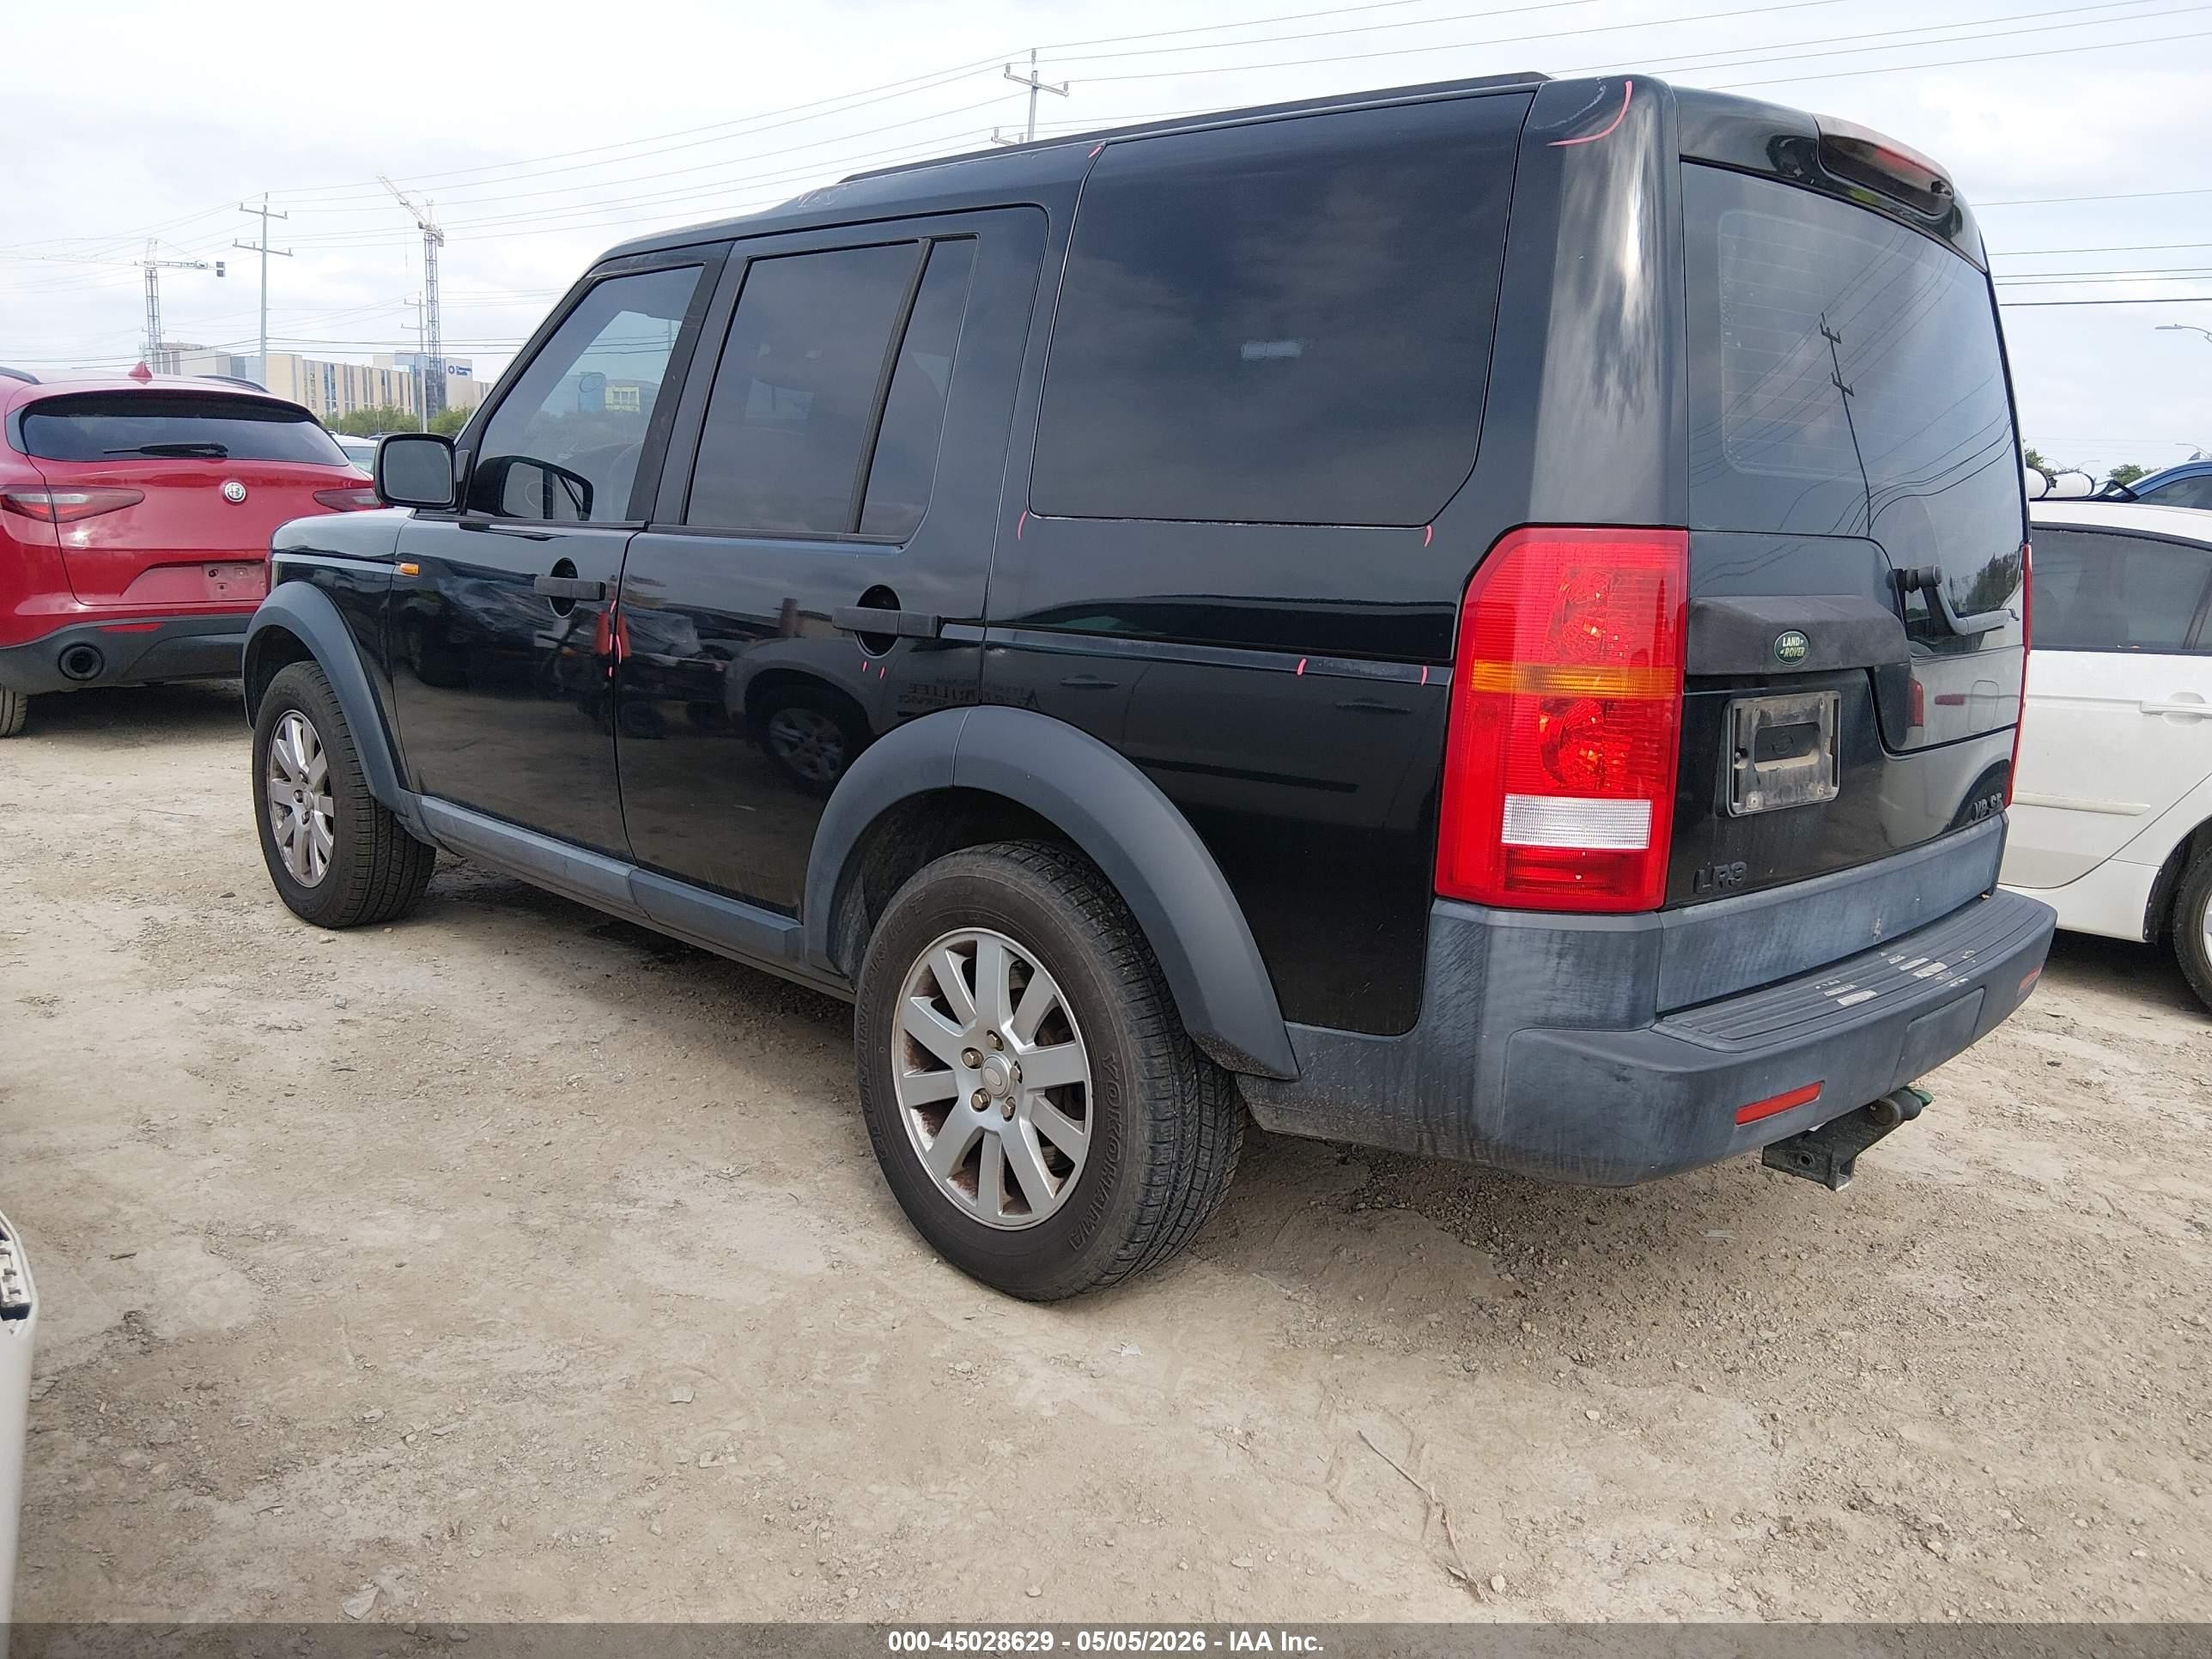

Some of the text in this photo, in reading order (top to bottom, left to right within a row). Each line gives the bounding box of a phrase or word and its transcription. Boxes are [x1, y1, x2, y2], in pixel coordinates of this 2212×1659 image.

[1782, 636, 1801, 647] LAND
[1784, 647, 1805, 658] ROVER
[1067, 1052, 1121, 1251] YOKOHAMA
